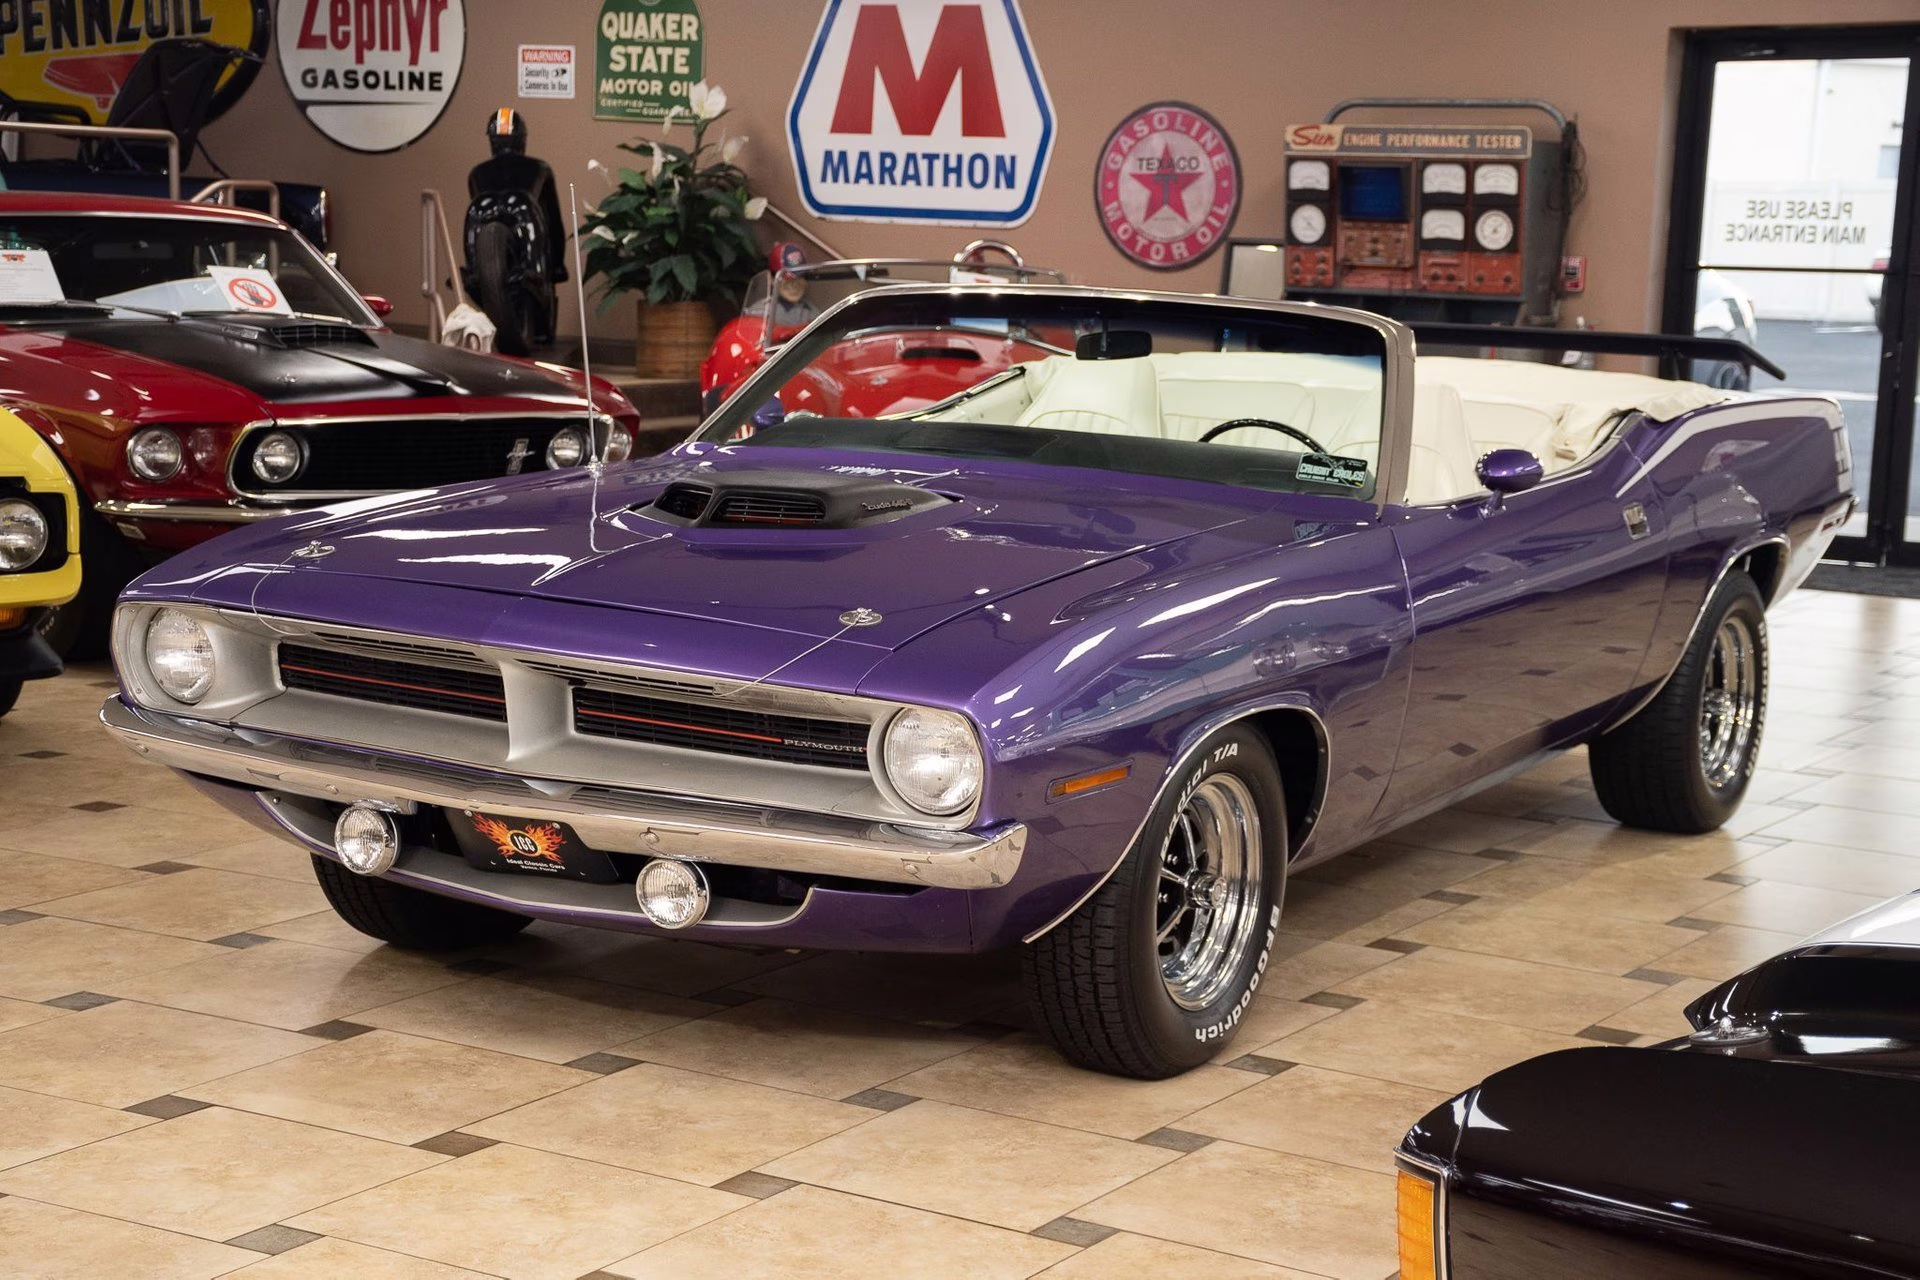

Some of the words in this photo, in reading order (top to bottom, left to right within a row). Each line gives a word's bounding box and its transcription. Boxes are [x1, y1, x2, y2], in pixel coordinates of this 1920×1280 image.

[0, 0, 213, 53] PENNZOIL
[296, 0, 448, 66] Zephyr
[602, 12, 699, 41] QUAKER
[524, 51, 569, 61] WARNING
[609, 46, 690, 74] STATE
[302, 68, 443, 91] GASOLINE
[525, 67, 549, 79] Security
[830, 4, 1007, 138] M
[525, 80, 549, 90] Cameras
[600, 78, 663, 96] MOTOR
[1107, 112, 1229, 170] GASOLINE
[1292, 125, 1336, 148] Sun
[1344, 133, 1382, 147] ENGINE
[1387, 133, 1470, 148] PERFORMANCE
[1475, 134, 1522, 149] TESTER
[820, 150, 1018, 190] MARATHON
[1136, 156, 1200, 171] TEXACO
[1104, 201, 1190, 261] MOTOR
[1195, 202, 1229, 244] OIL
[783, 739, 864, 753] PLYMOUTH
[1214, 742, 1239, 763] T/A
[513, 836, 535, 852] ICC
